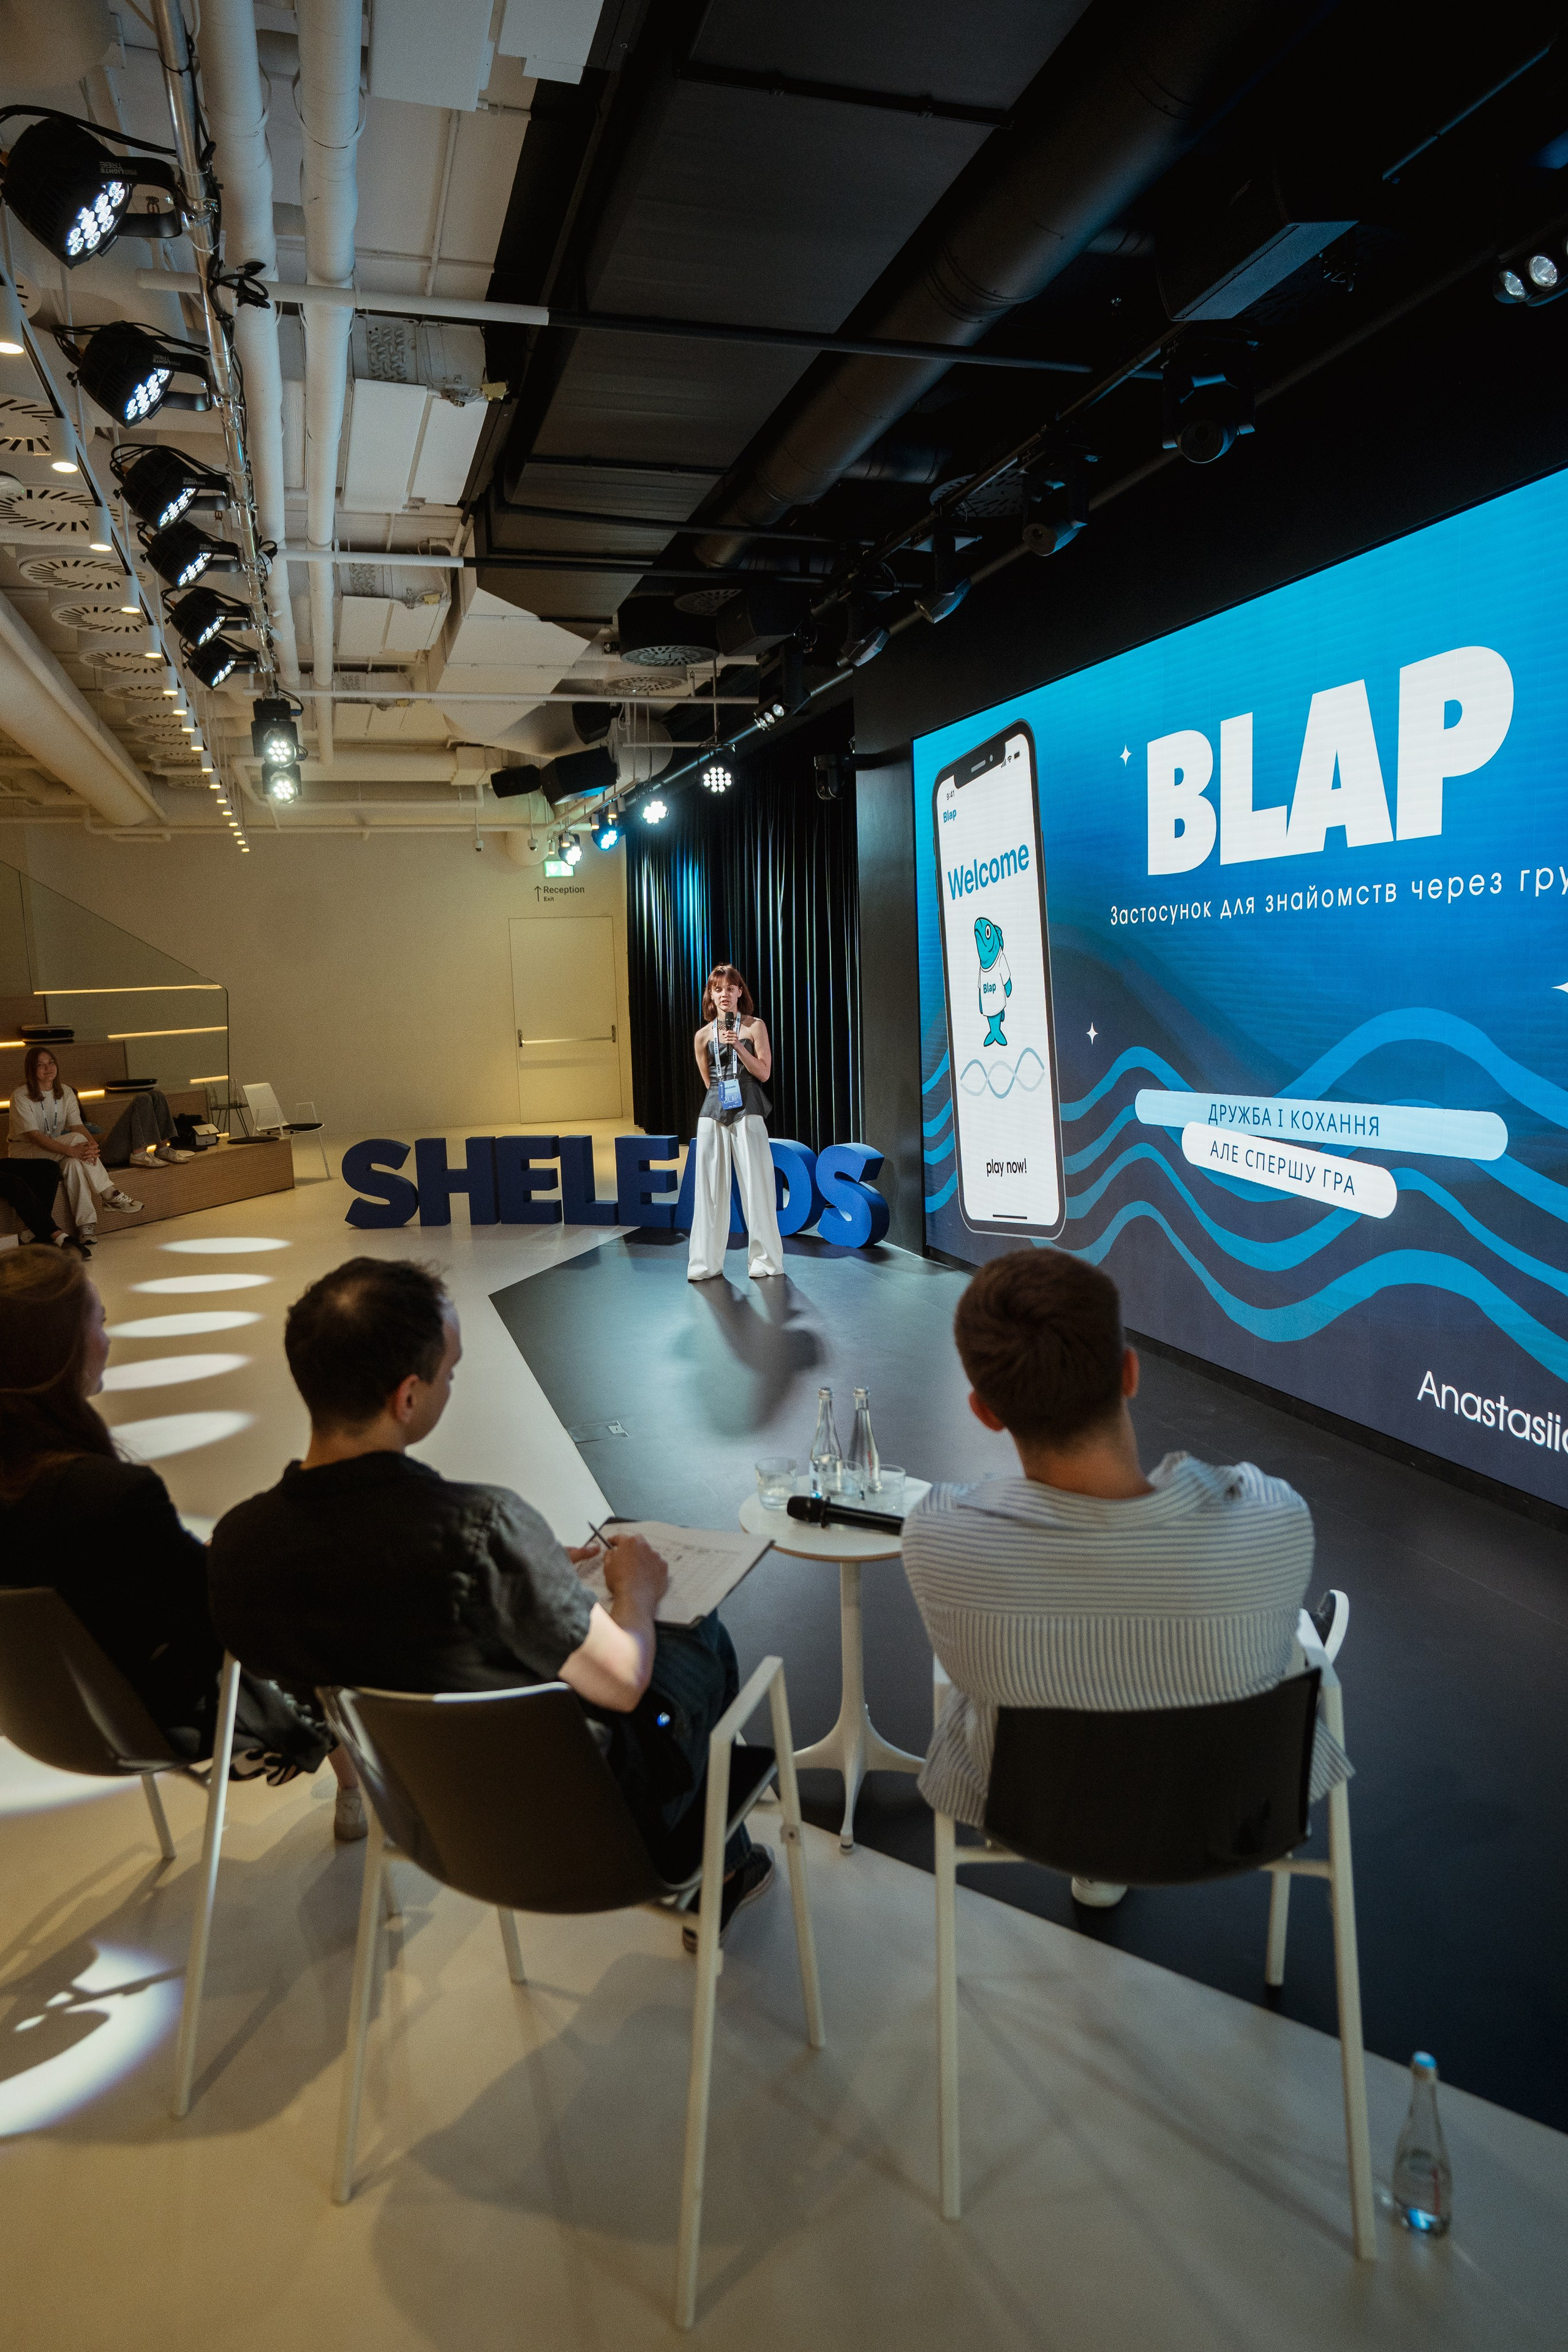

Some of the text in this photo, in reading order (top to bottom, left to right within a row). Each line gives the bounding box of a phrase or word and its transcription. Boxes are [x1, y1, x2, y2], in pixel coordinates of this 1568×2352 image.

[1147, 646, 1514, 875] BLAP
[946, 790, 955, 801] 9:41
[943, 809, 957, 823] Blap
[947, 844, 1030, 900] Welcome
[543, 886, 585, 895] Reception
[1110, 901, 1212, 925] Застосунок
[1220, 897, 1254, 919] для
[1265, 883, 1396, 913] знайомств
[1411, 872, 1502, 904] через
[983, 982, 997, 994] Blap
[1208, 1103, 1272, 1126] ДРУЖБА
[1291, 1110, 1379, 1137] КОХАННЯ
[986, 1158, 1027, 1177] play now!
[1210, 1140, 1355, 1196] АЛЕ СПЕРШУ ГРА
[1417, 1370, 1568, 1455] Anastasii
